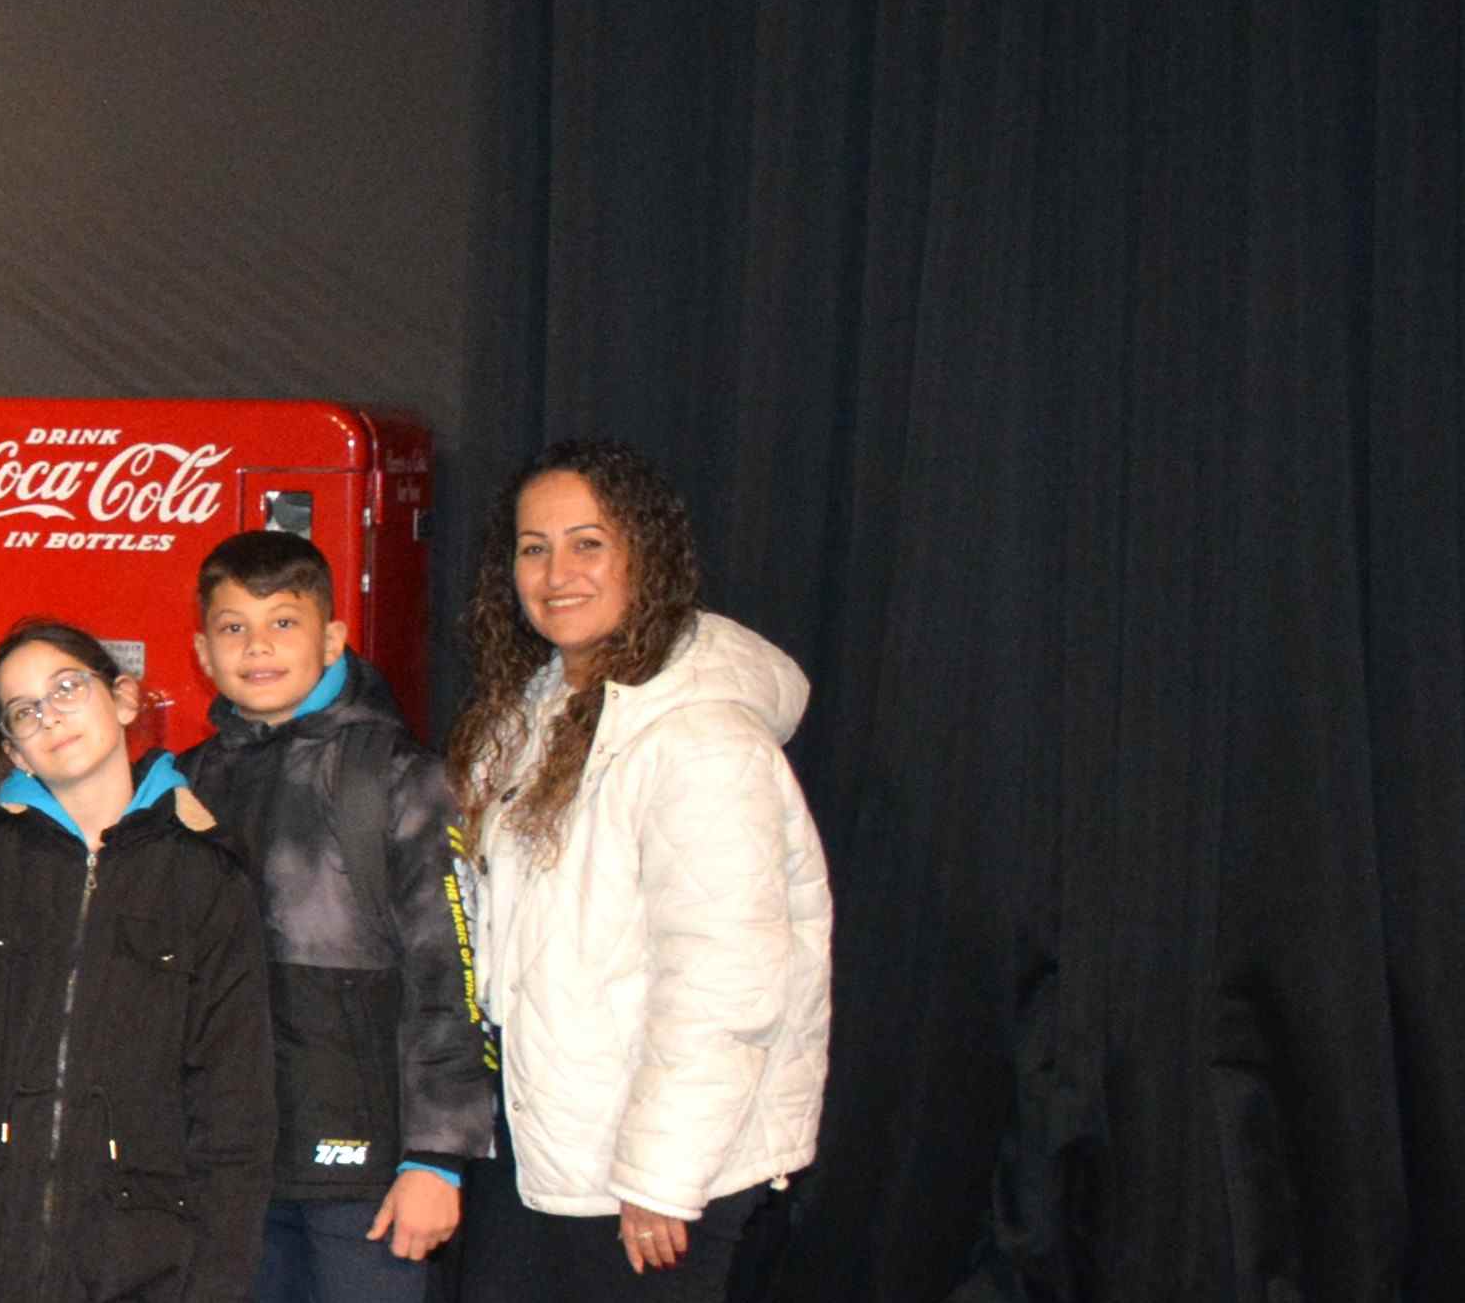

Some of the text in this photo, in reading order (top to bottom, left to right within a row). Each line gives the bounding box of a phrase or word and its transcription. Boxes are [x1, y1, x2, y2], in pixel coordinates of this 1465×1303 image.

[25, 428, 122, 445] DRINK
[4, 531, 176, 551] IN BOTTLES
[444, 874, 460, 902] THE
[452, 902, 469, 945] MAGIC
[459, 947, 473, 967] OF
